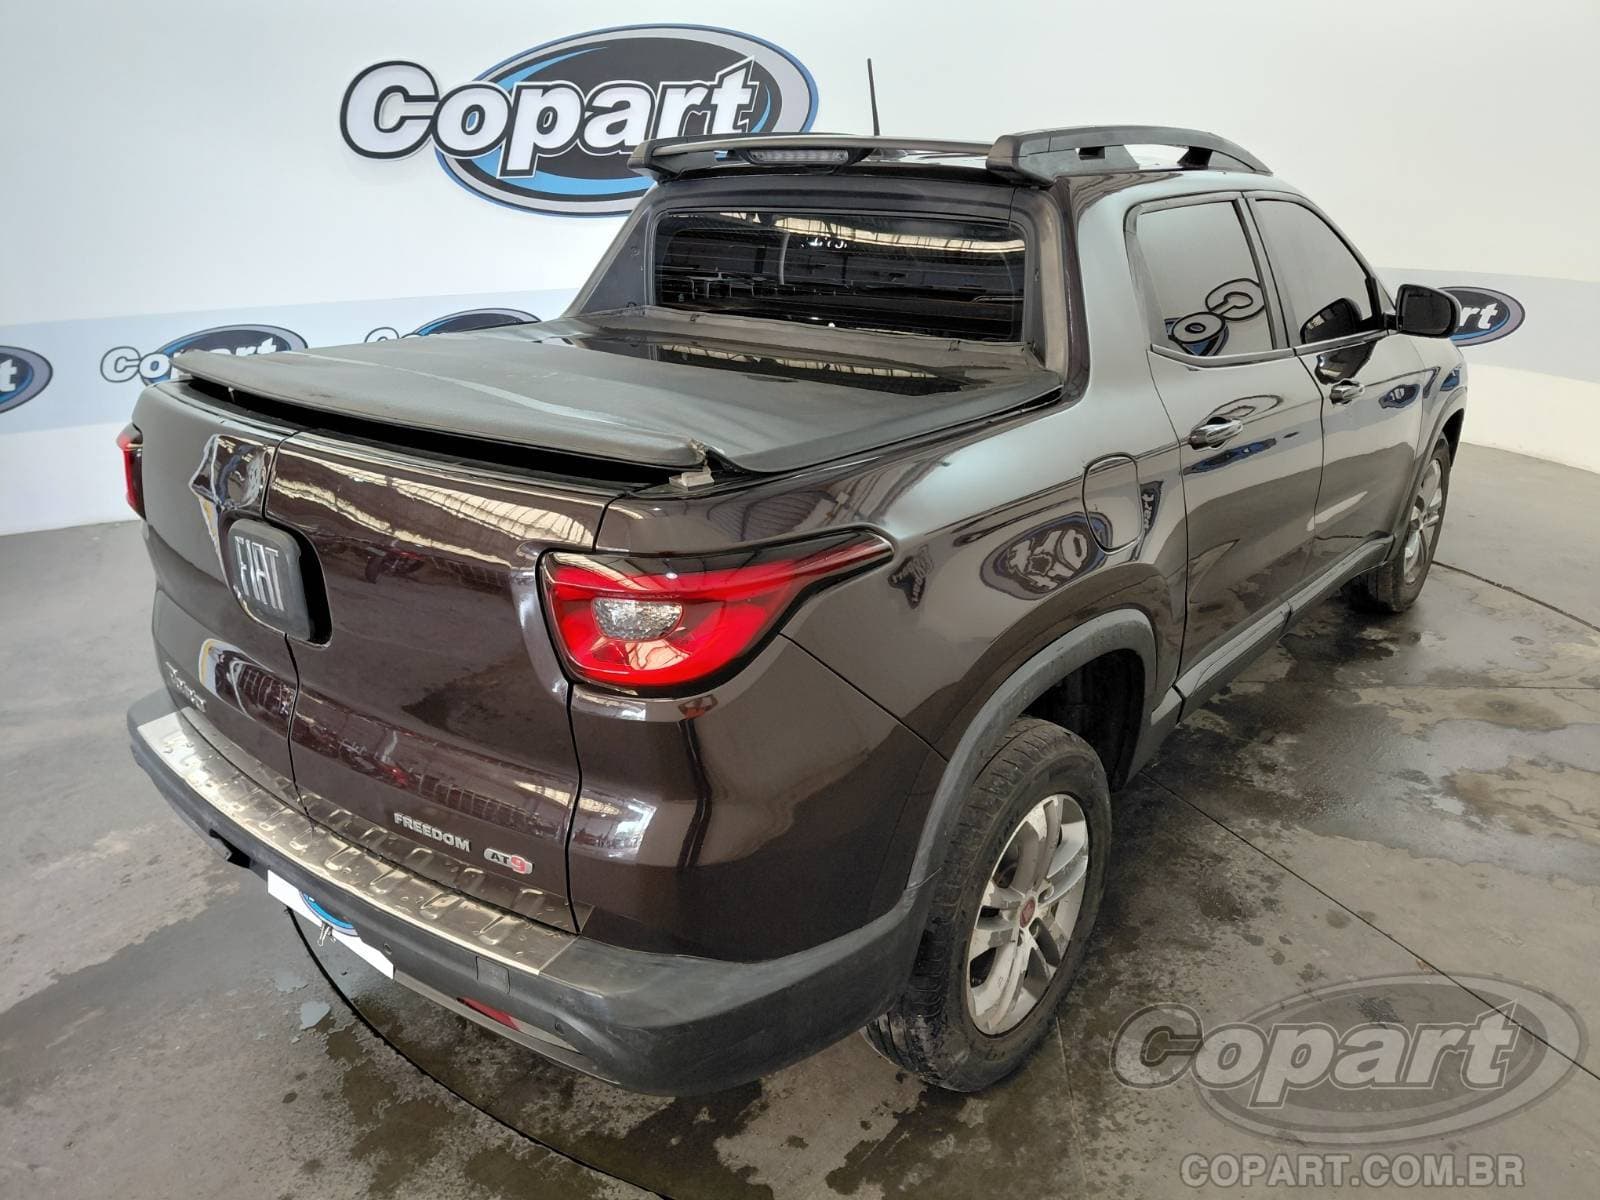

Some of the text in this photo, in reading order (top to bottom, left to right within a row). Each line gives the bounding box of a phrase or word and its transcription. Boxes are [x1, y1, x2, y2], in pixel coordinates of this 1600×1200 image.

[340, 57, 758, 177] Copart
[234, 535, 284, 611] FIAT
[393, 812, 528, 874] FREEDOM AT9
